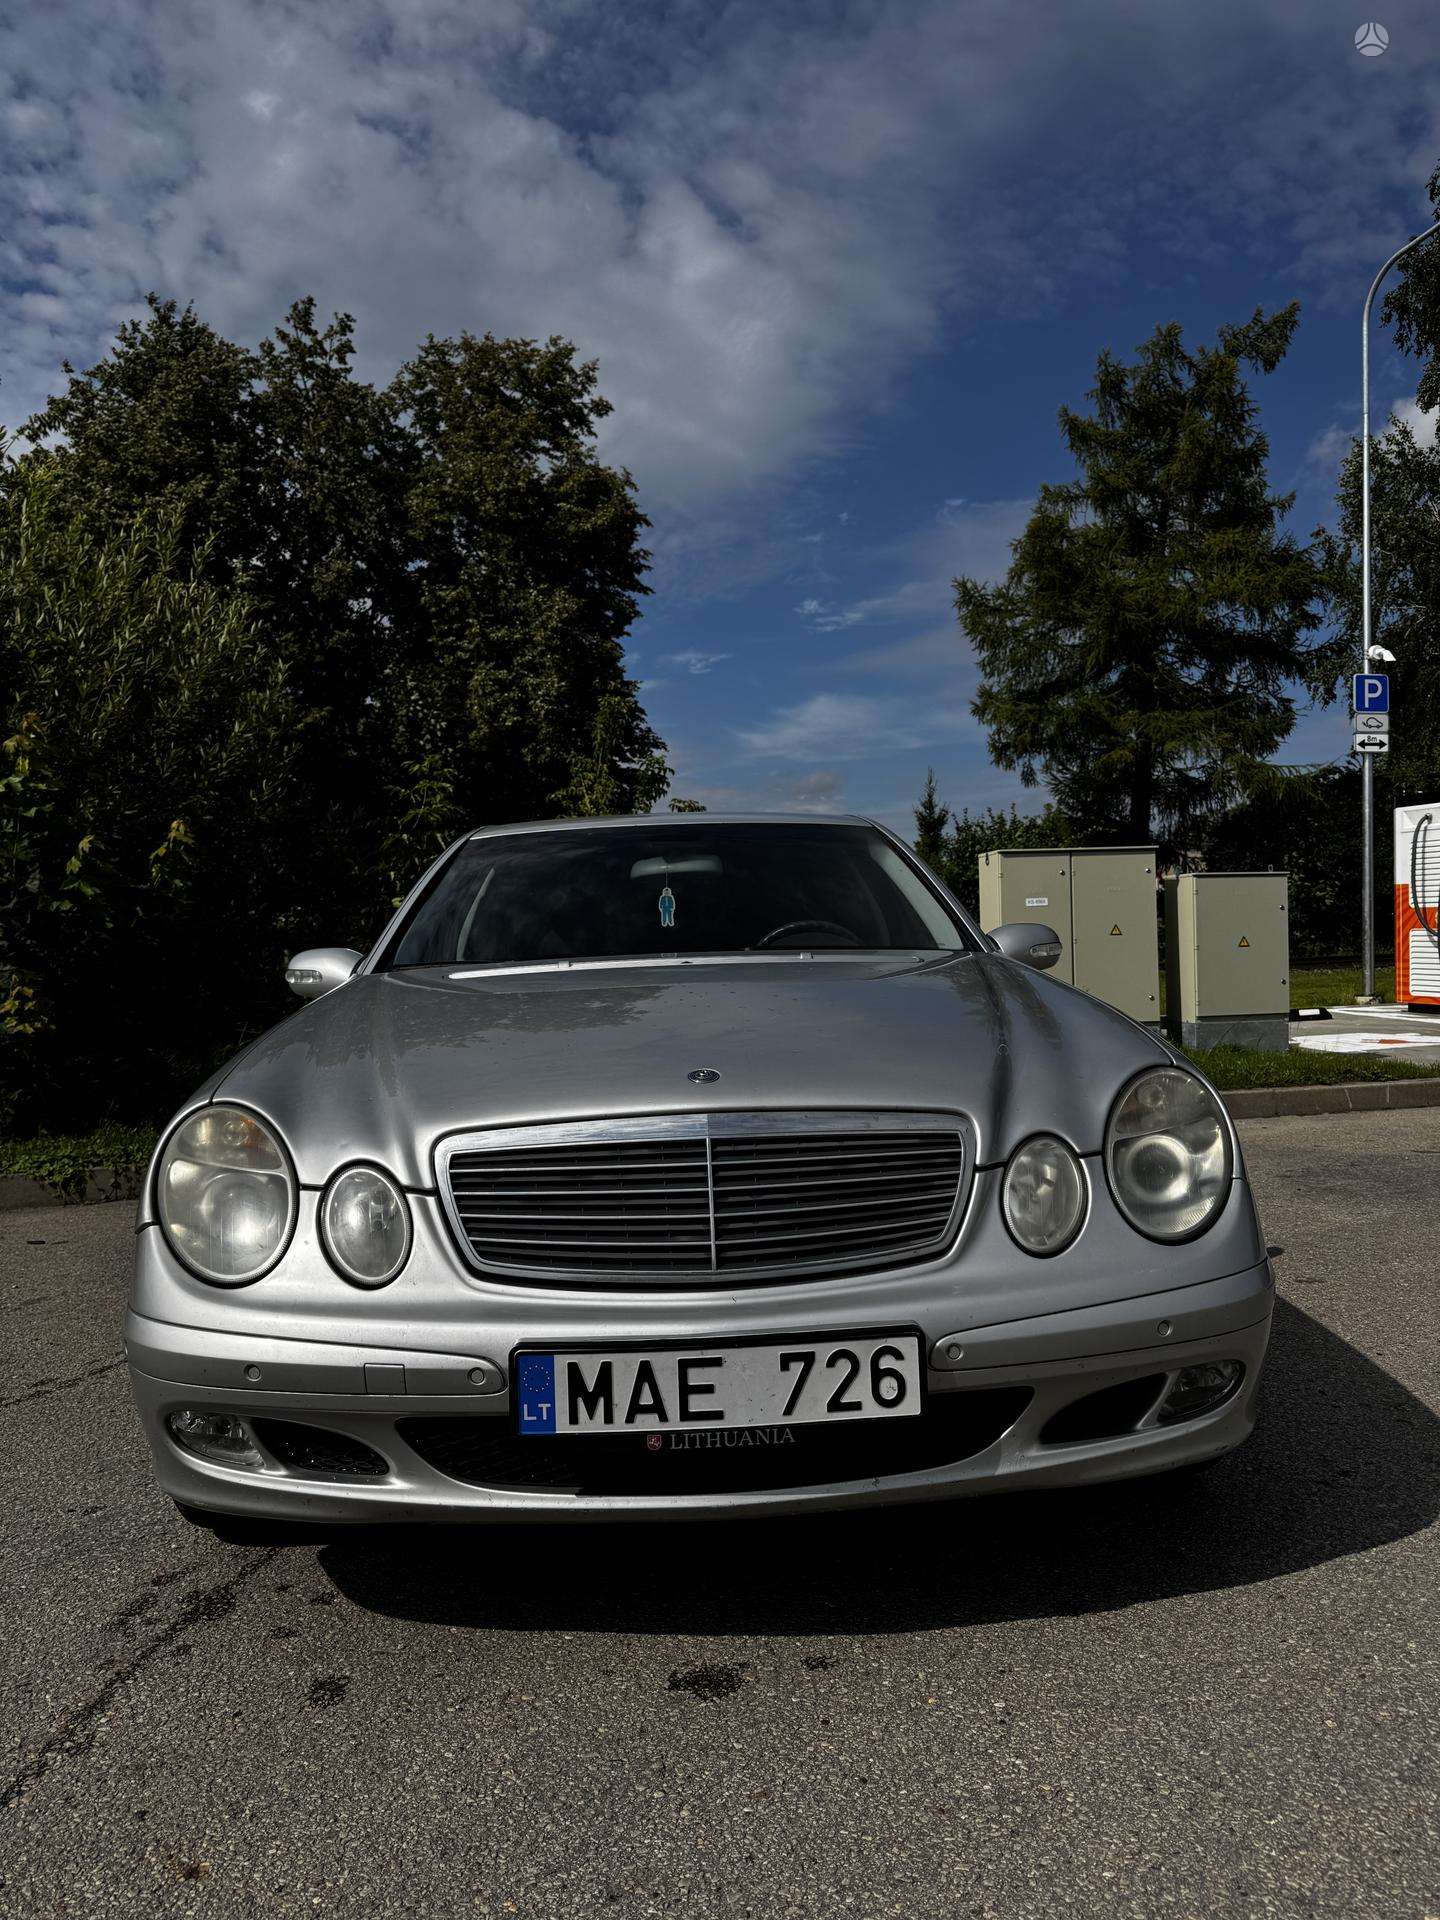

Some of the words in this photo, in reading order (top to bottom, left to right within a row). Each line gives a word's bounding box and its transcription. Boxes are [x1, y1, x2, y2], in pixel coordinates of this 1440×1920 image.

[1364, 679, 1383, 708] P
[567, 1356, 725, 1425] MAE
[779, 1345, 907, 1416] 726
[523, 1403, 552, 1421] LT
[670, 1428, 796, 1450] LITHUANIA
